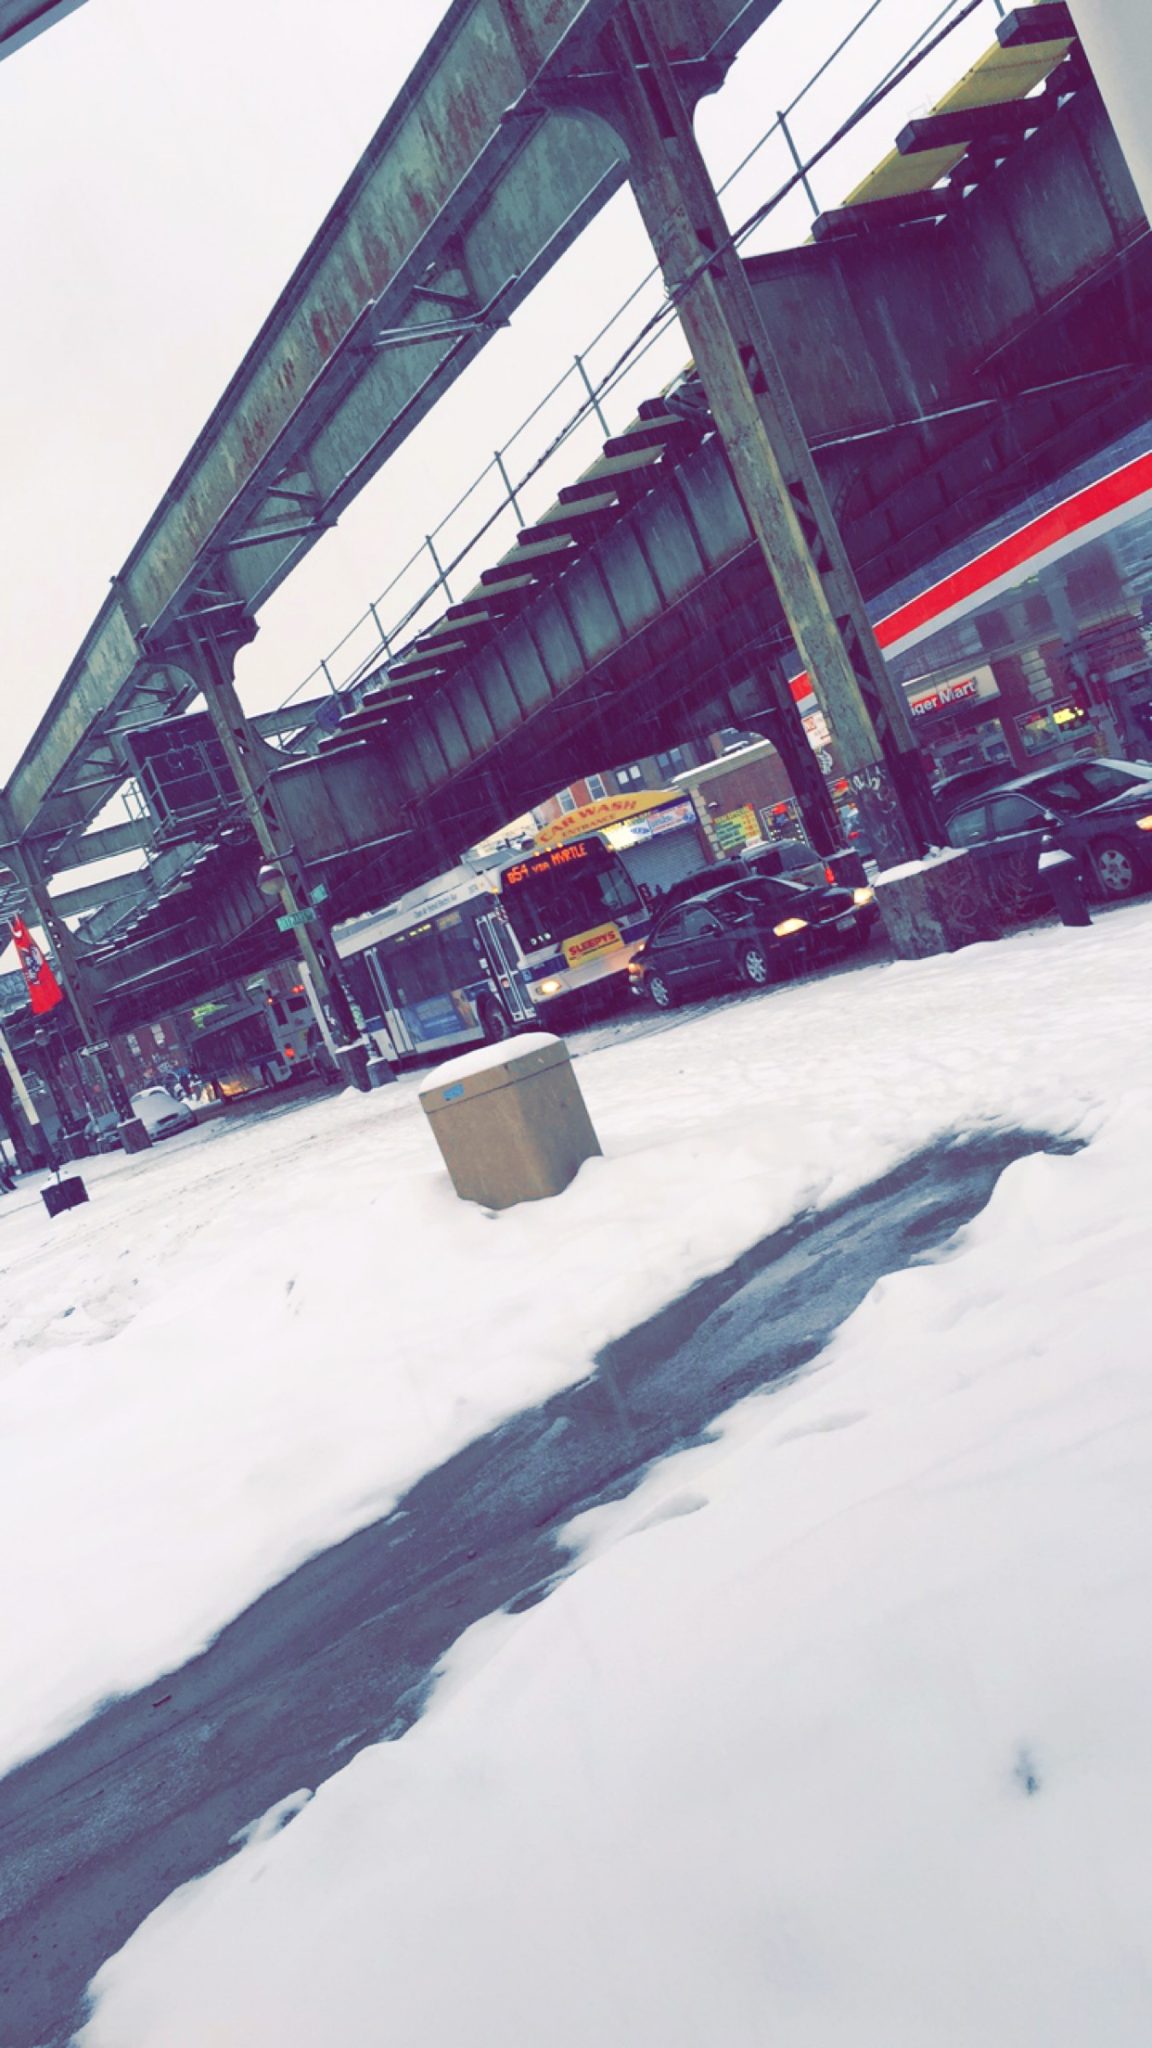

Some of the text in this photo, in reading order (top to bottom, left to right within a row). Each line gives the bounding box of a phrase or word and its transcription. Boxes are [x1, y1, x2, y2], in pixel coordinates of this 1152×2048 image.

[938, 679, 977, 705] Mart
[540, 815, 576, 842] CAR
[579, 800, 637, 819] WASH
[562, 813, 615, 838] ENTRANCE
[551, 842, 588, 866] MYRTLE
